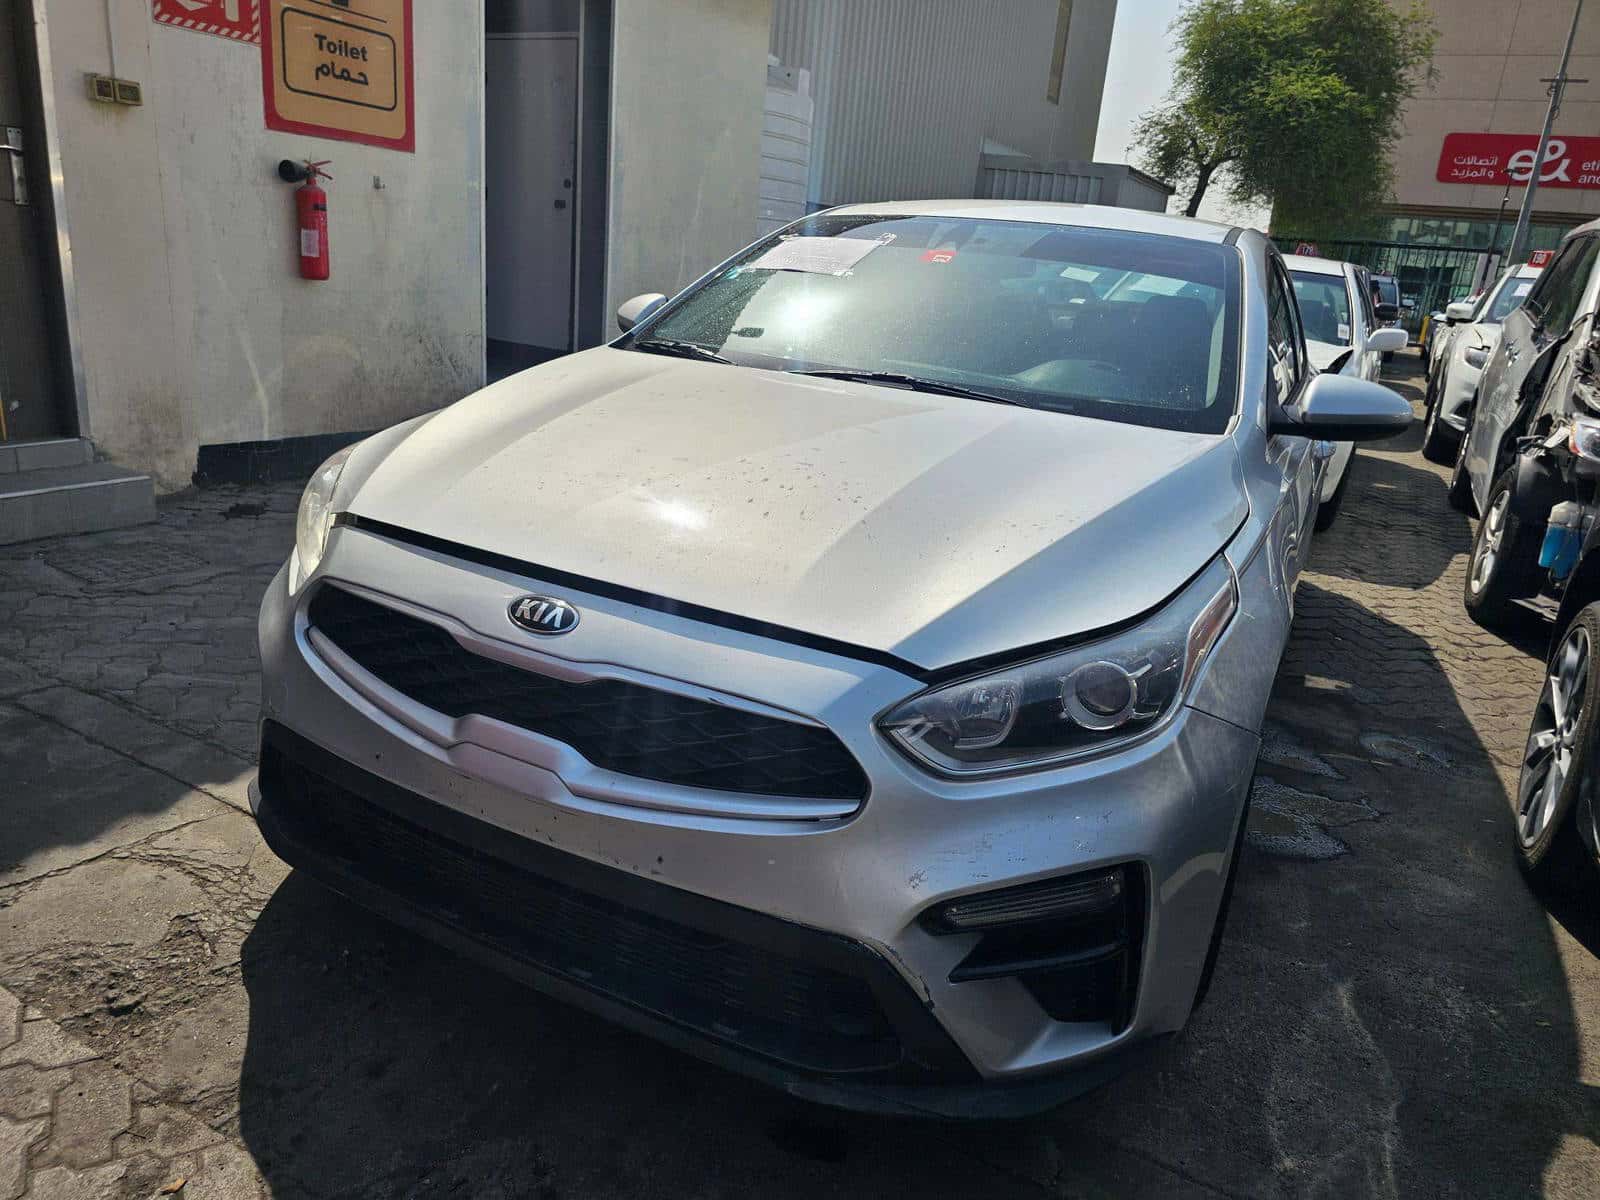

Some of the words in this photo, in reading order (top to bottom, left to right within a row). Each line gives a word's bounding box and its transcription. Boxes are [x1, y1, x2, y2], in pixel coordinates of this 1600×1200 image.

[314, 33, 369, 62] Toilet
[315, 61, 369, 86] حمام
[1453, 154, 1498, 166] اتصالات
[515, 599, 565, 629] KIA
